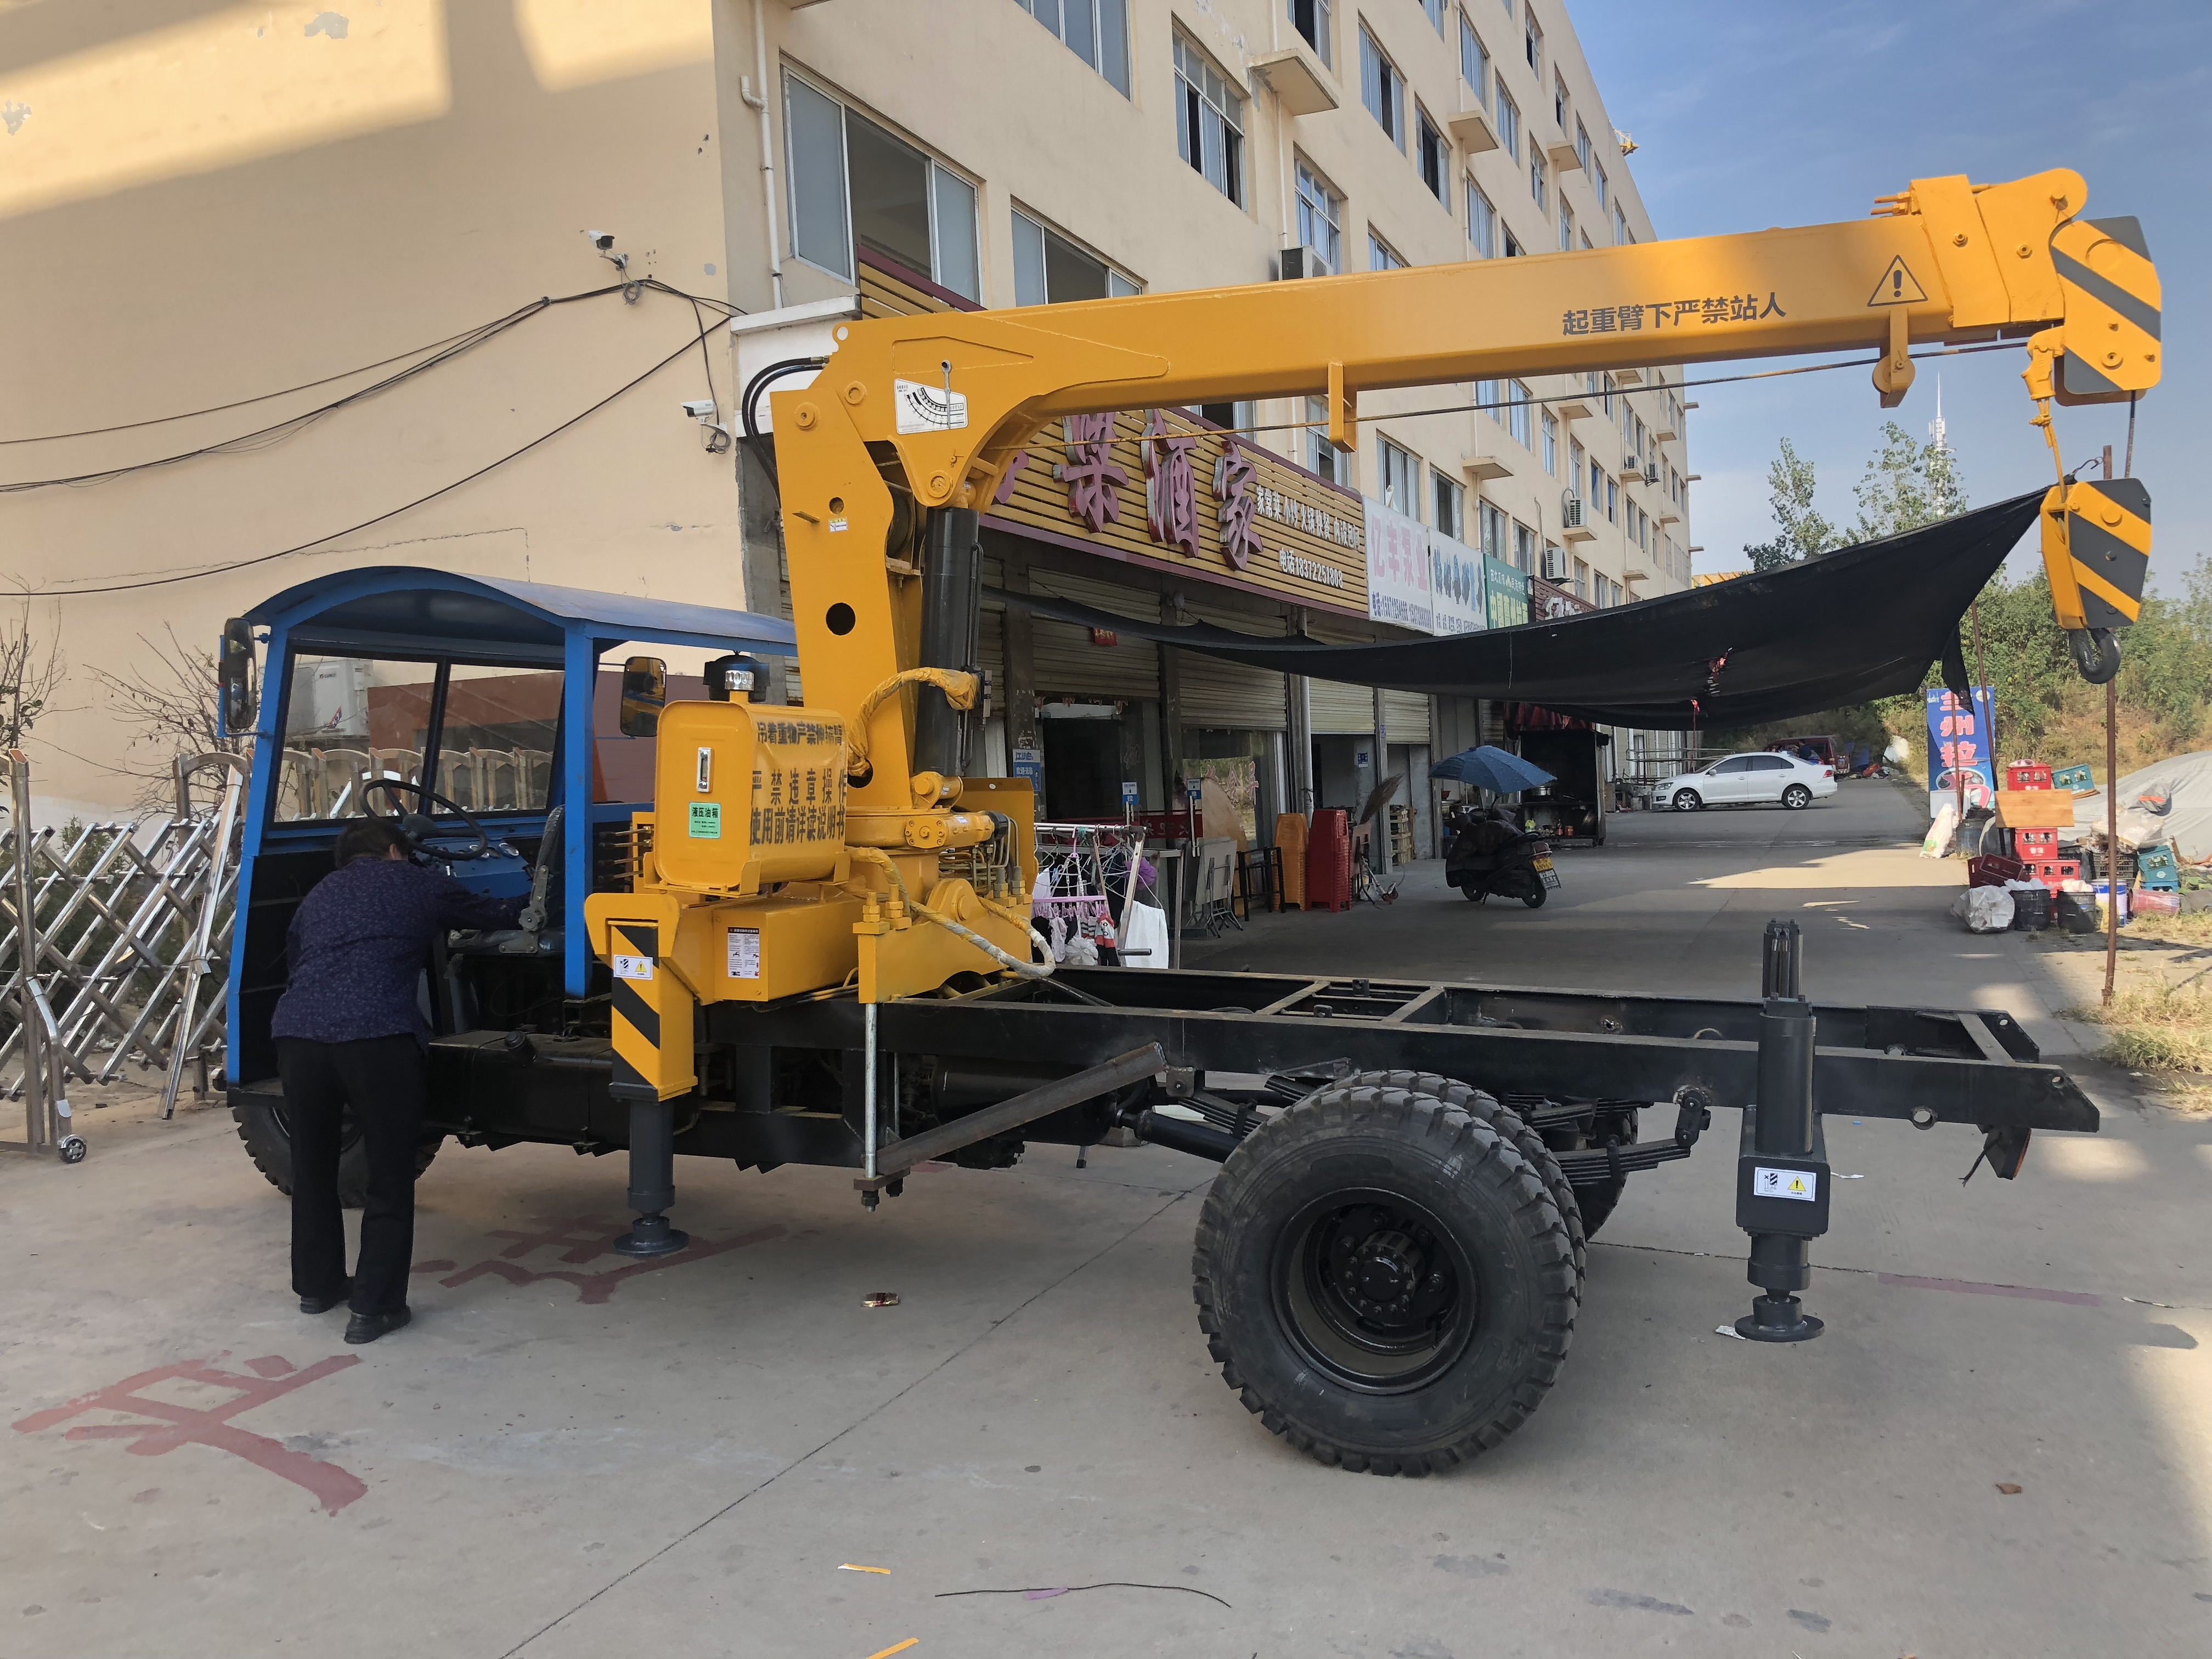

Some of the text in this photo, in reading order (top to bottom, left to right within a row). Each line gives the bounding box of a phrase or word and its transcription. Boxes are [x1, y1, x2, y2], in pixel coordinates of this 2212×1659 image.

[1562, 292, 1786, 336] 起重臂下严禁站人
[1255, 485, 1281, 521] 家常菜
[1283, 496, 1298, 528] 小炒
[1333, 517, 1360, 550] 内设包间
[1370, 514, 1428, 592] 亿丰泵业
[757, 720, 843, 746] 吊着重物严禁伸缩臂
[751, 768, 848, 806] 严禁违章操作
[692, 806, 719, 819] 液压油箱
[750, 804, 846, 847] 使用前请详读说明书
